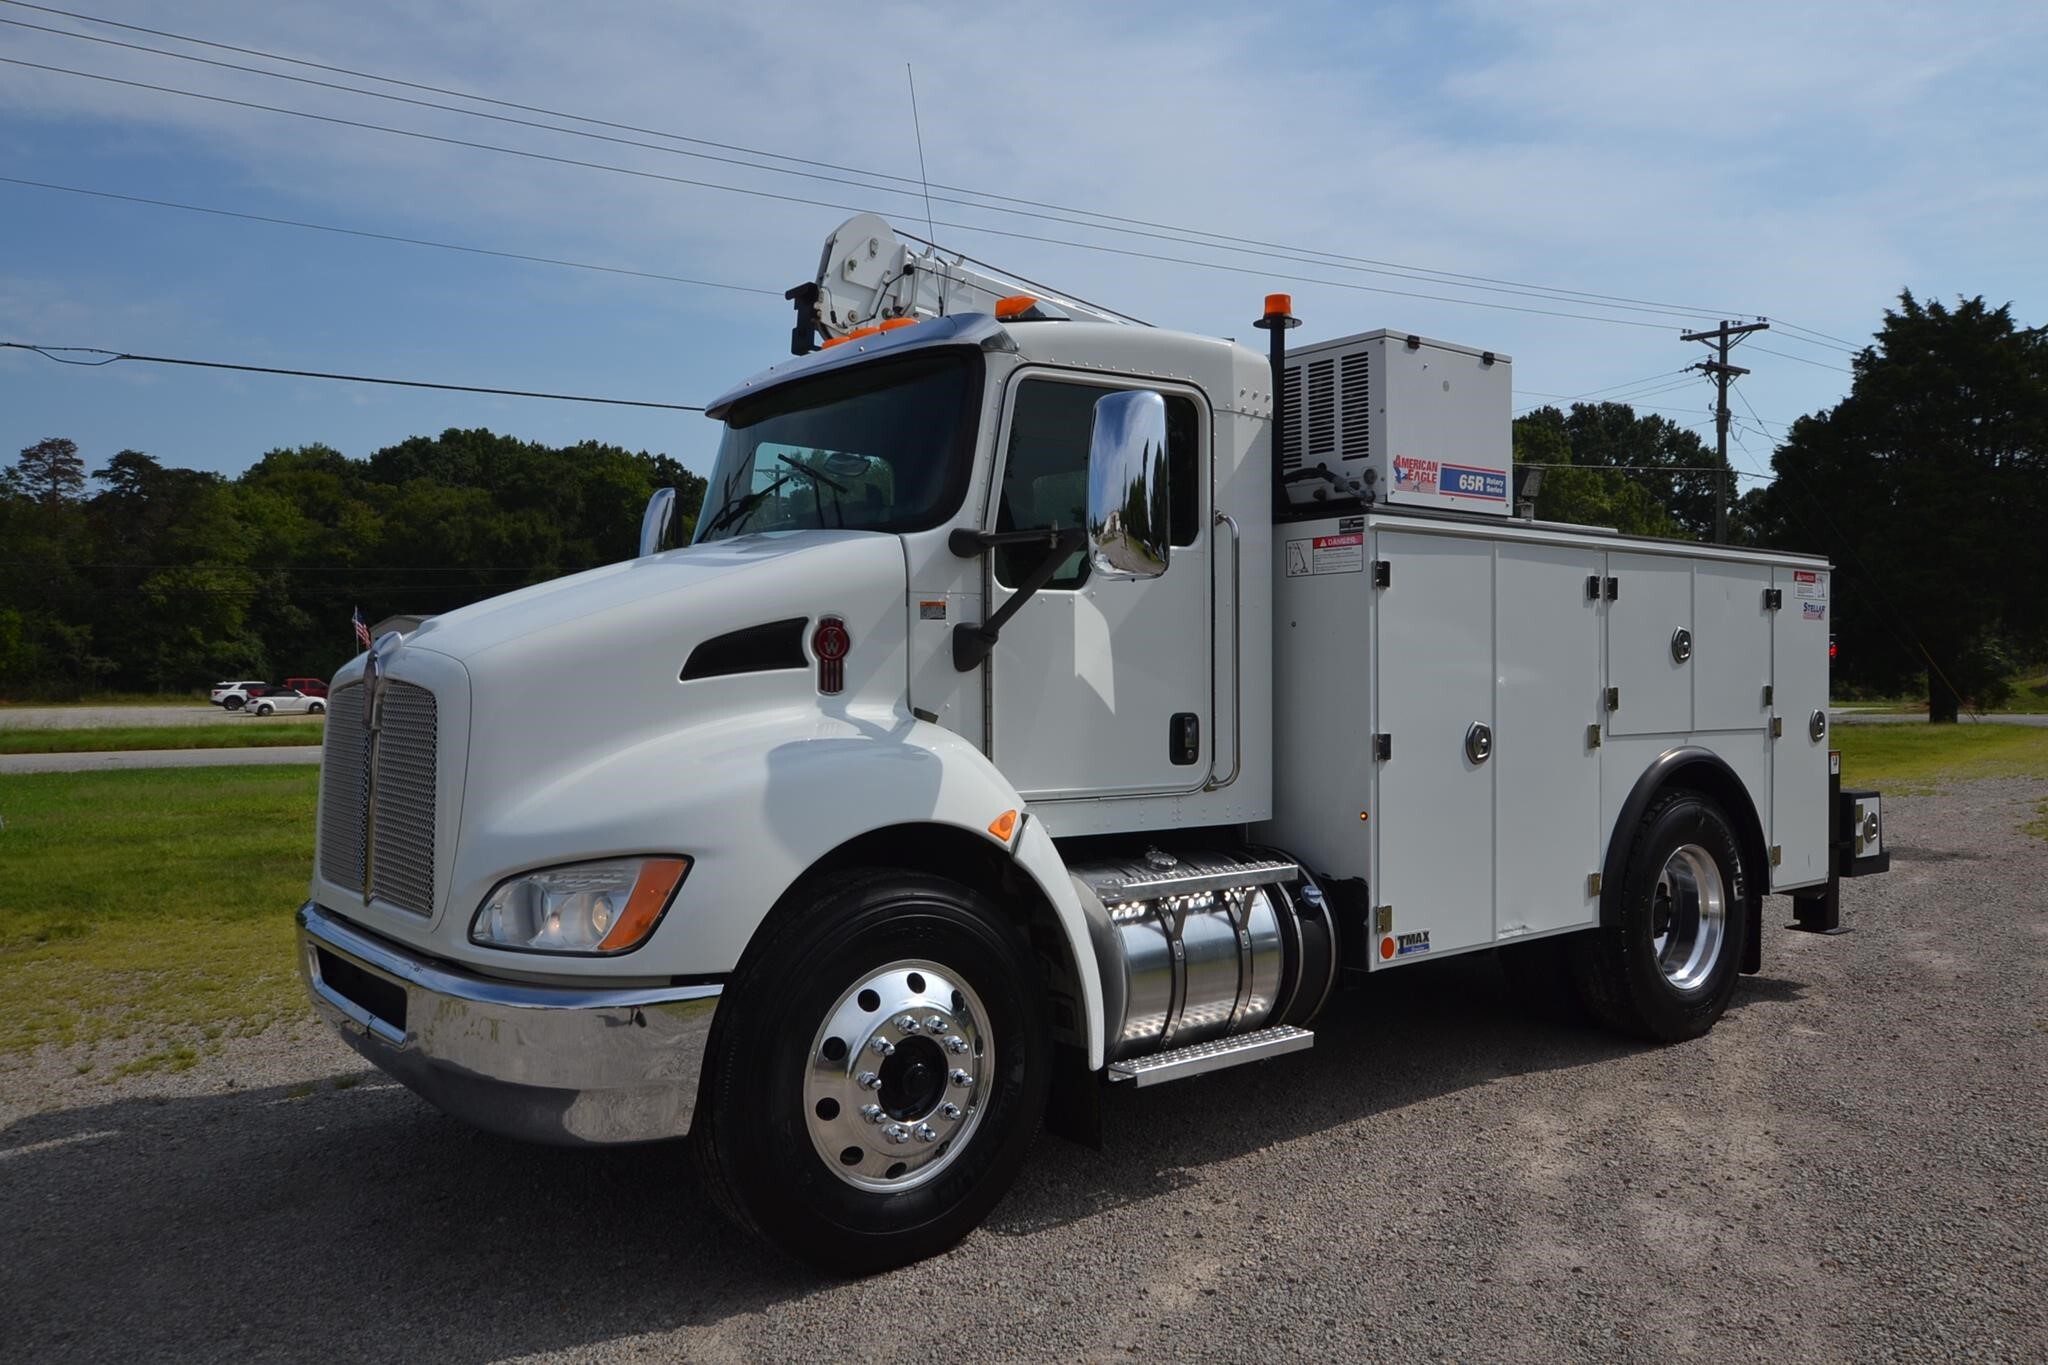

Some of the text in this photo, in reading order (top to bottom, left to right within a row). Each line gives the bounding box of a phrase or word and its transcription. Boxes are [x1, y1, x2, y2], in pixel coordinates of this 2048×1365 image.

[1395, 454, 1438, 473] AMERICAN
[1407, 469, 1437, 483] EAGLE
[1459, 473, 1485, 492] 65R
[1327, 536, 1356, 546] DANGER
[1397, 931, 1430, 954] TMAX
